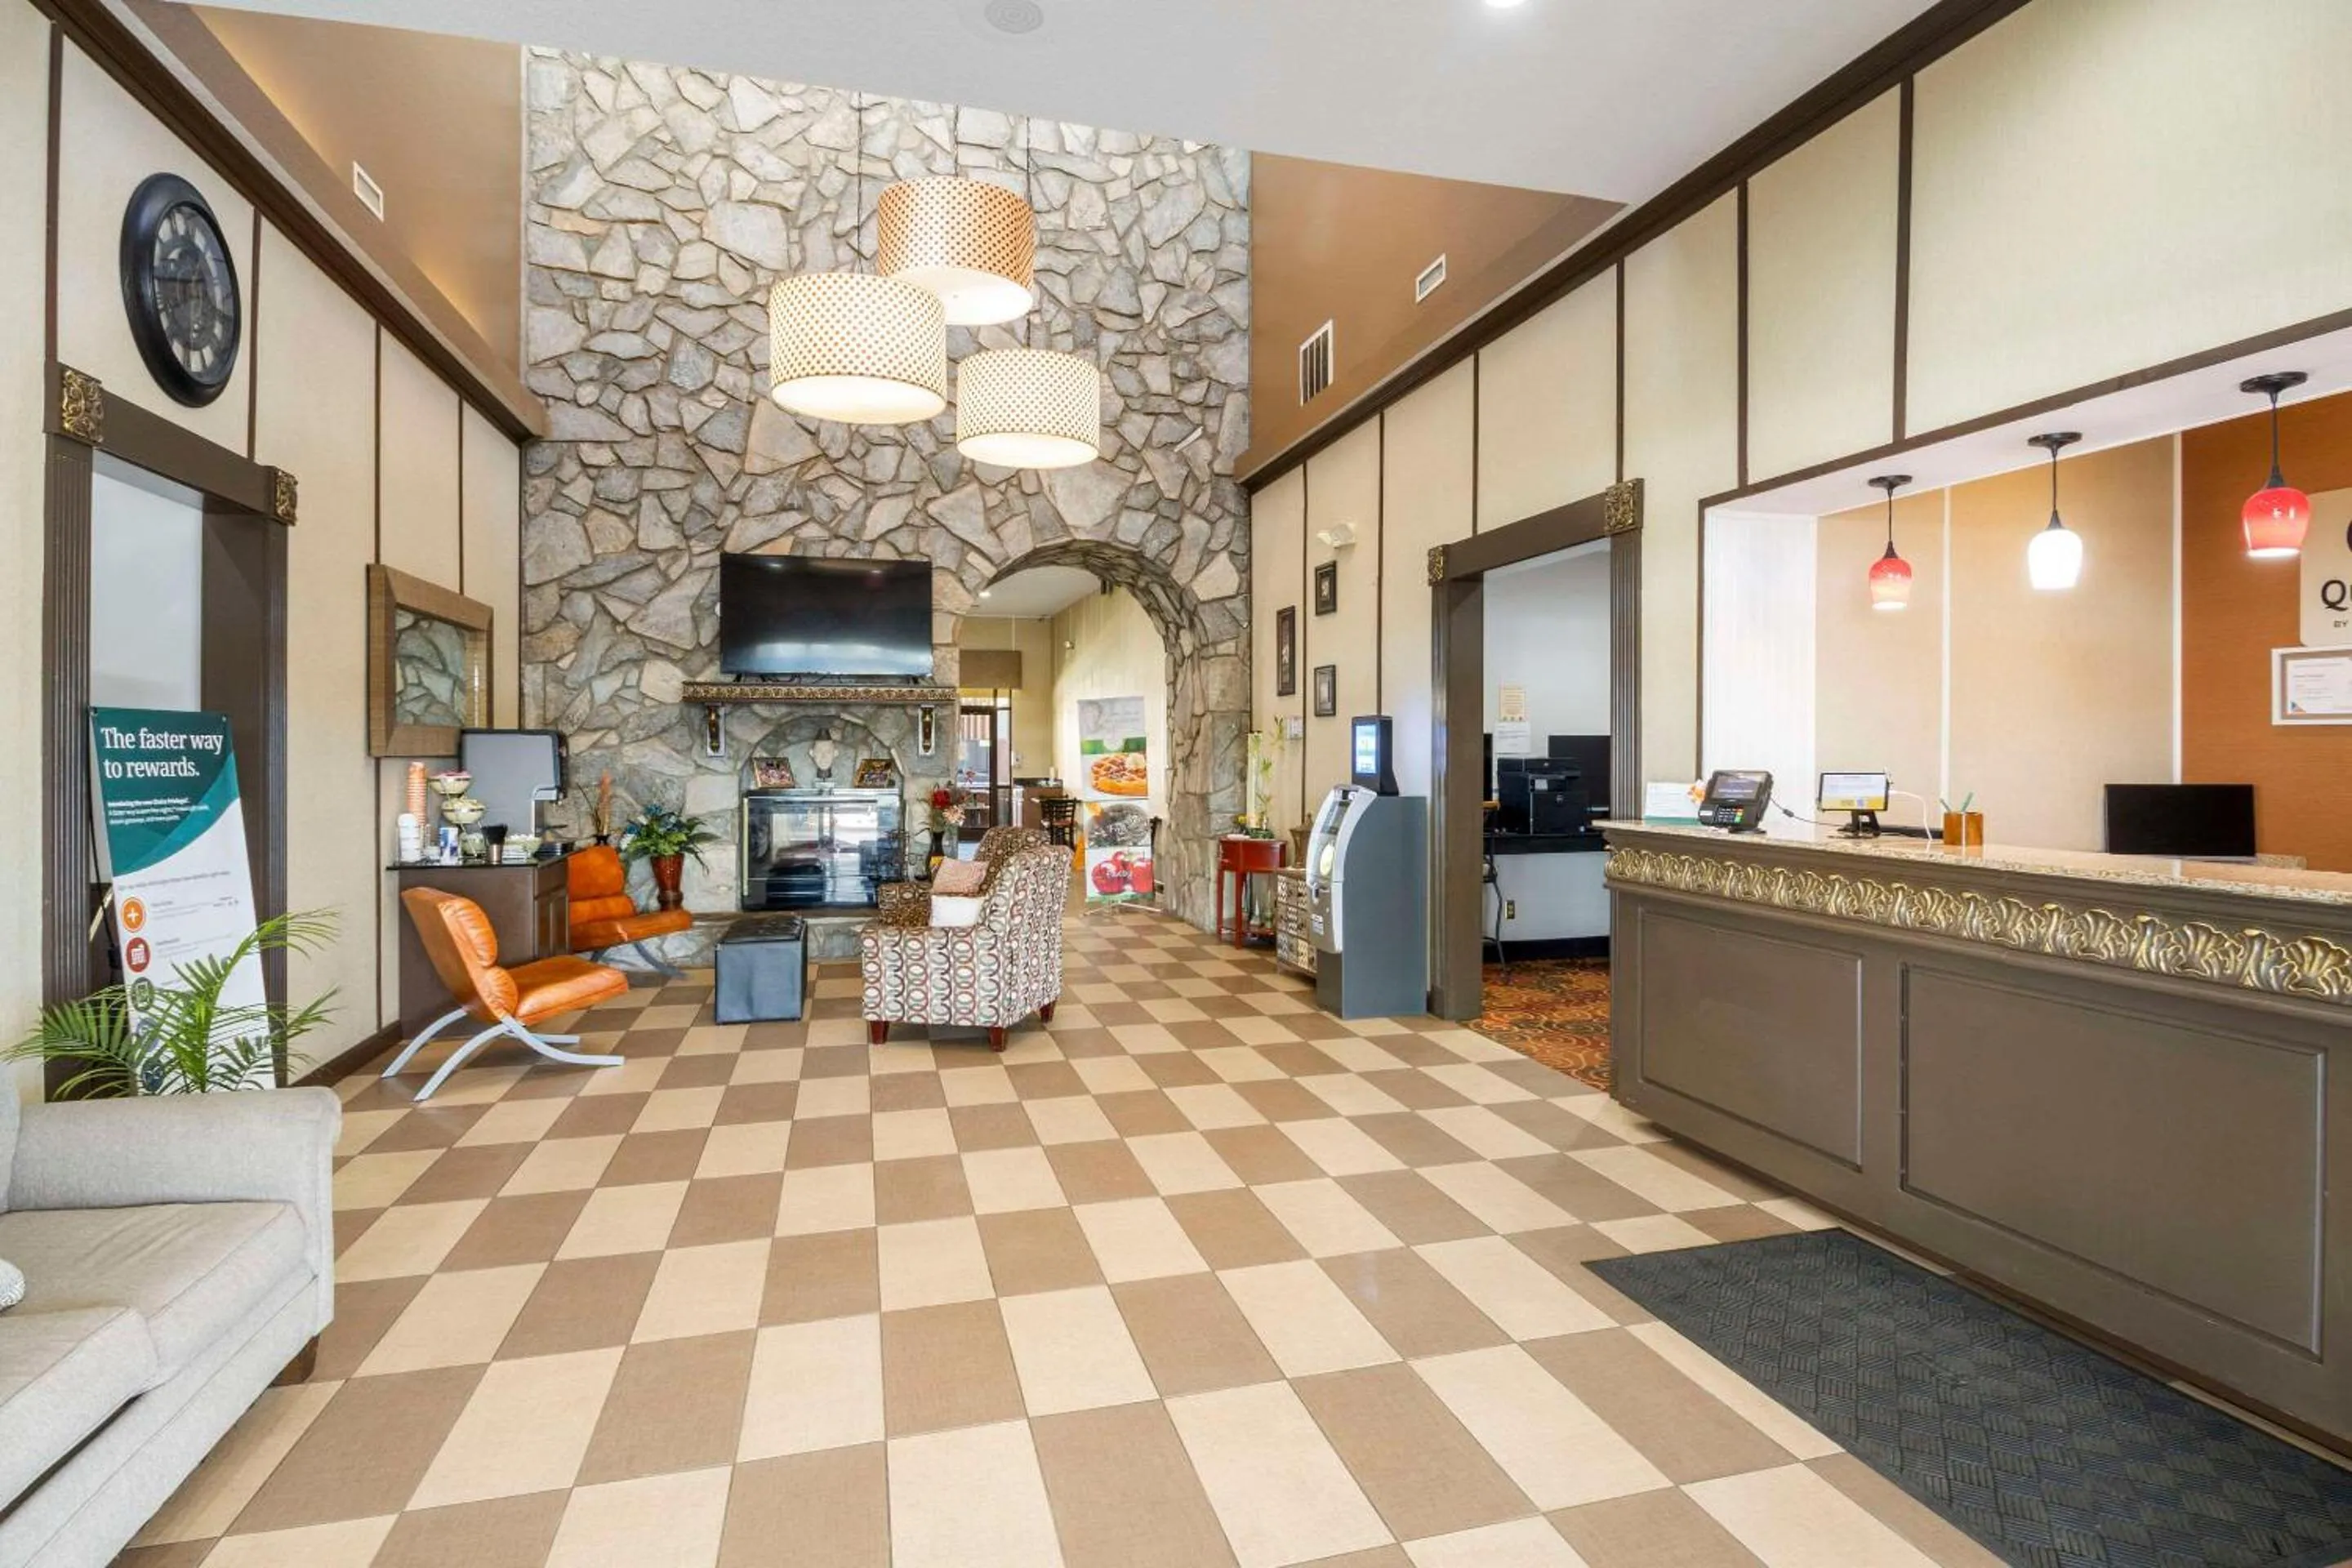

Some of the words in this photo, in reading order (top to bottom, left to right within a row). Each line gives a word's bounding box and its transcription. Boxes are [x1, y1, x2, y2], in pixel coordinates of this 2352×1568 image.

[2321, 579, 2352, 612] Q
[100, 727, 136, 749] The
[139, 727, 187, 750] faster
[189, 734, 223, 755] way
[103, 758, 122, 778] to
[126, 755, 200, 778] rewards.
